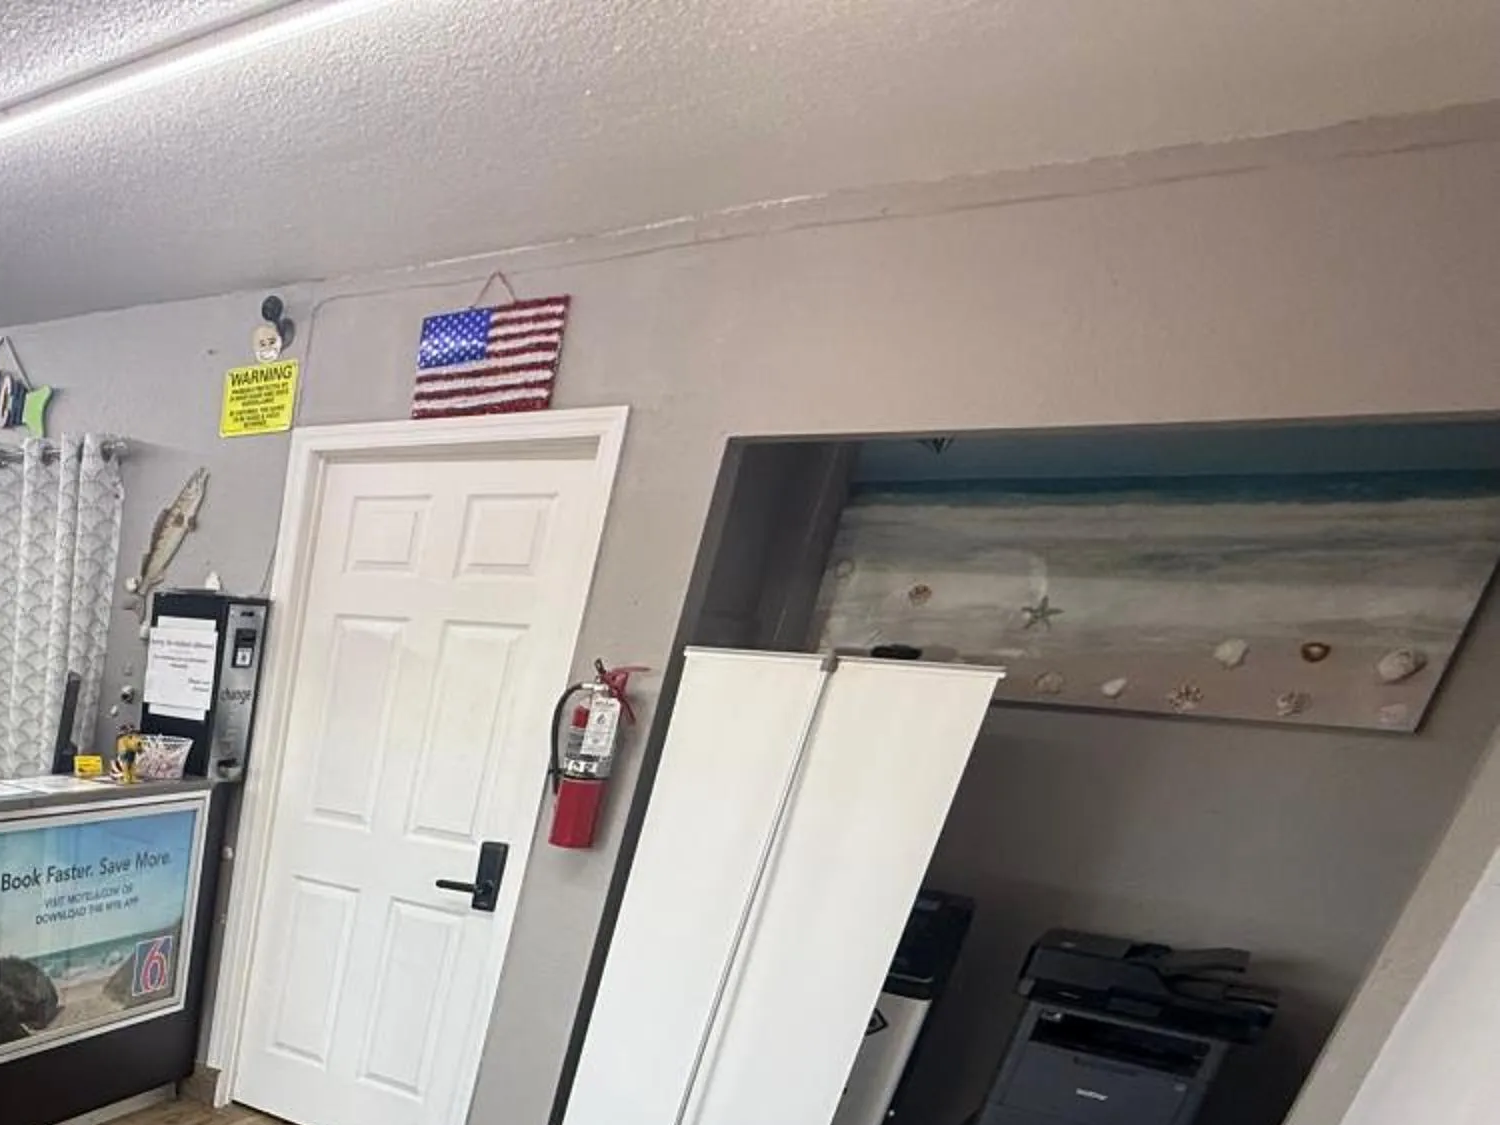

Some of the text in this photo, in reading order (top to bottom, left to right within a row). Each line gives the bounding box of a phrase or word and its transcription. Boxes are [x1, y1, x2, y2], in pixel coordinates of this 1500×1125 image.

[228, 365, 293, 386] WARNING
[1, 867, 42, 892] Book
[46, 863, 94, 885] Faster.
[99, 857, 131, 875] Save
[140, 940, 169, 994] 6
